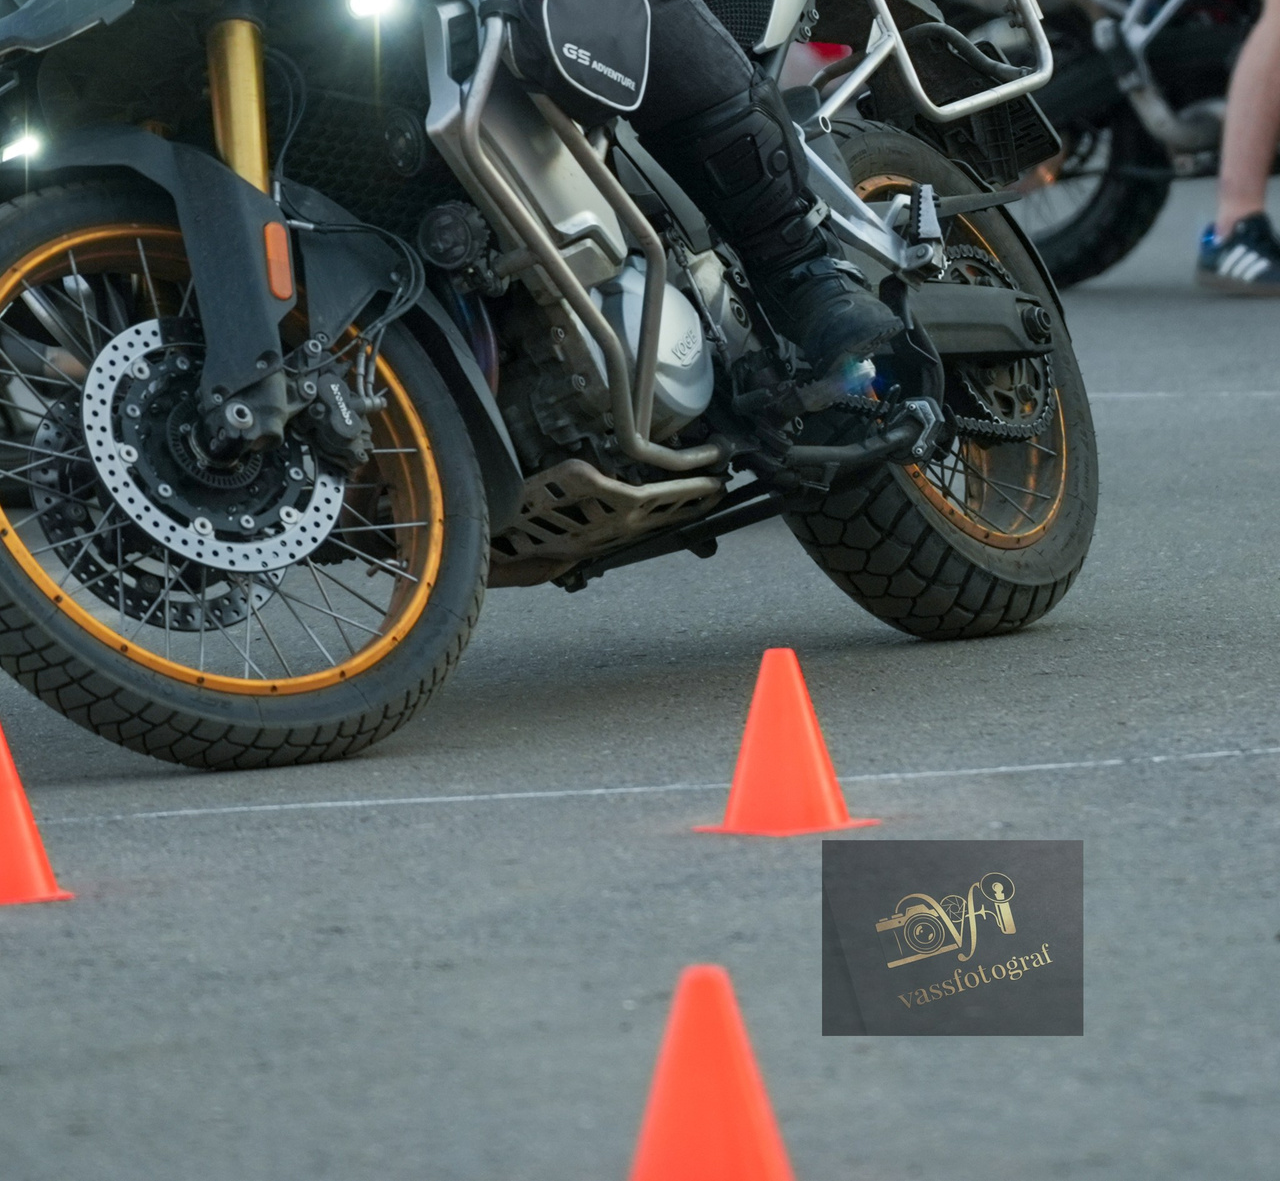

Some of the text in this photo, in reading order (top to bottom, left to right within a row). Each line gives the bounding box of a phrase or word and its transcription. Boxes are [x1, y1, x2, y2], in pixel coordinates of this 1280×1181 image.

[562, 43, 636, 92] GS ADVENTURE
[671, 328, 698, 361] VOGE
[330, 383, 353, 426] brembo
